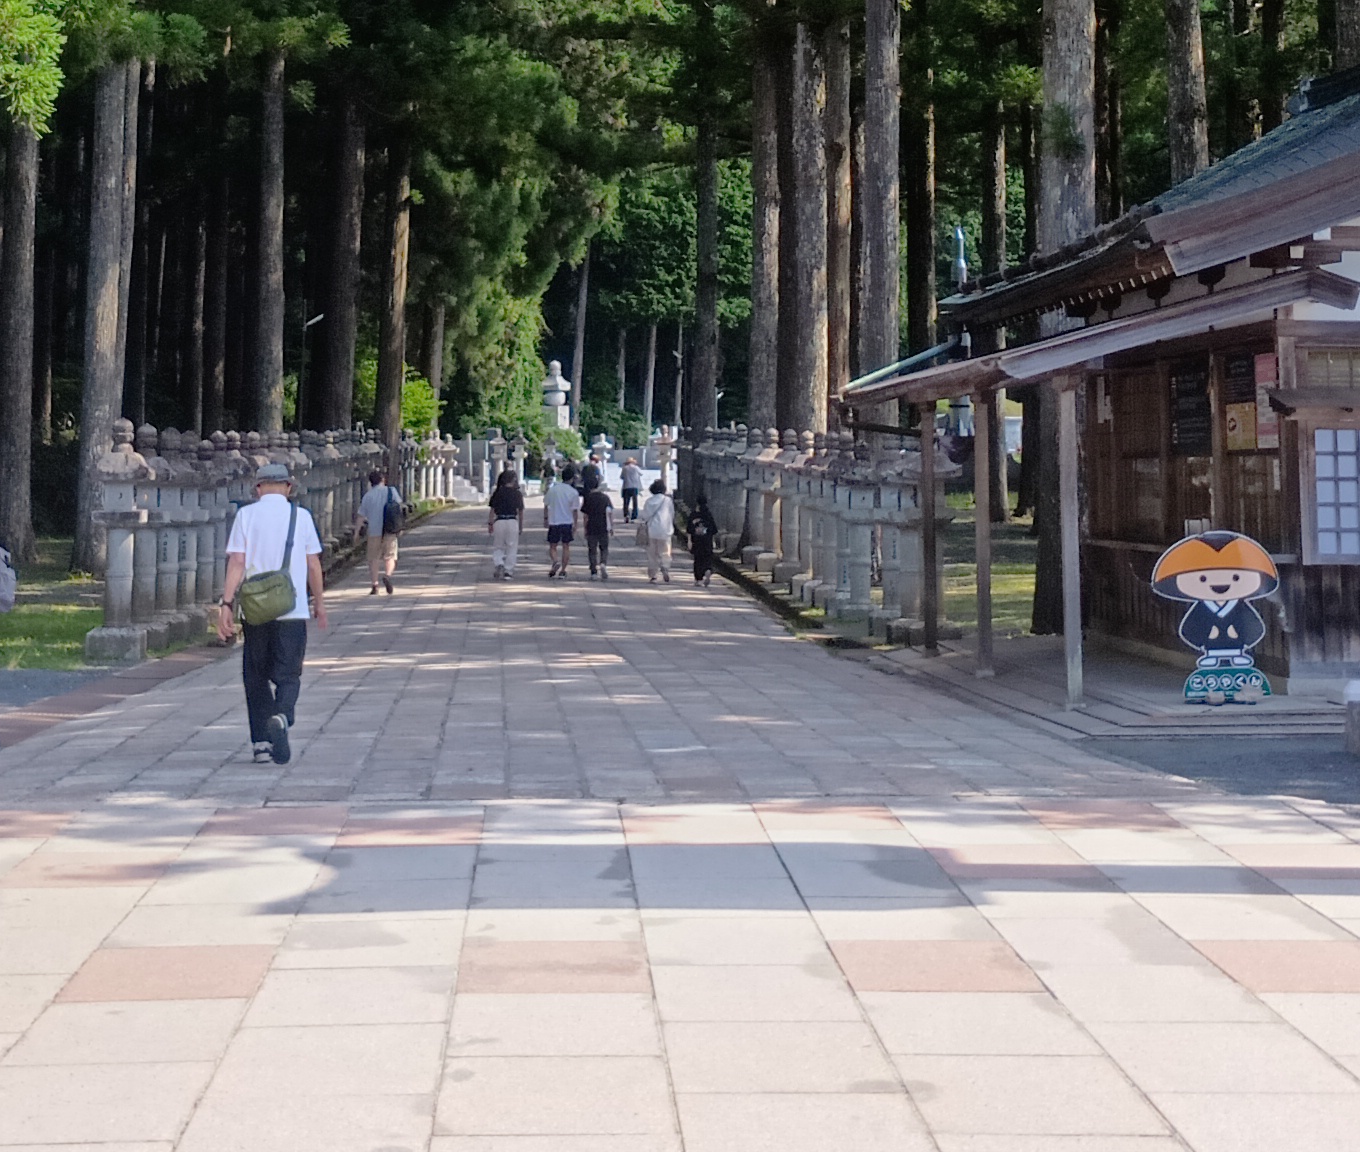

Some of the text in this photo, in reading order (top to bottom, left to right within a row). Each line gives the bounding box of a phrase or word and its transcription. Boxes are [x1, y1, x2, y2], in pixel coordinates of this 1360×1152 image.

[1192, 675, 1261, 689] こうやくん
